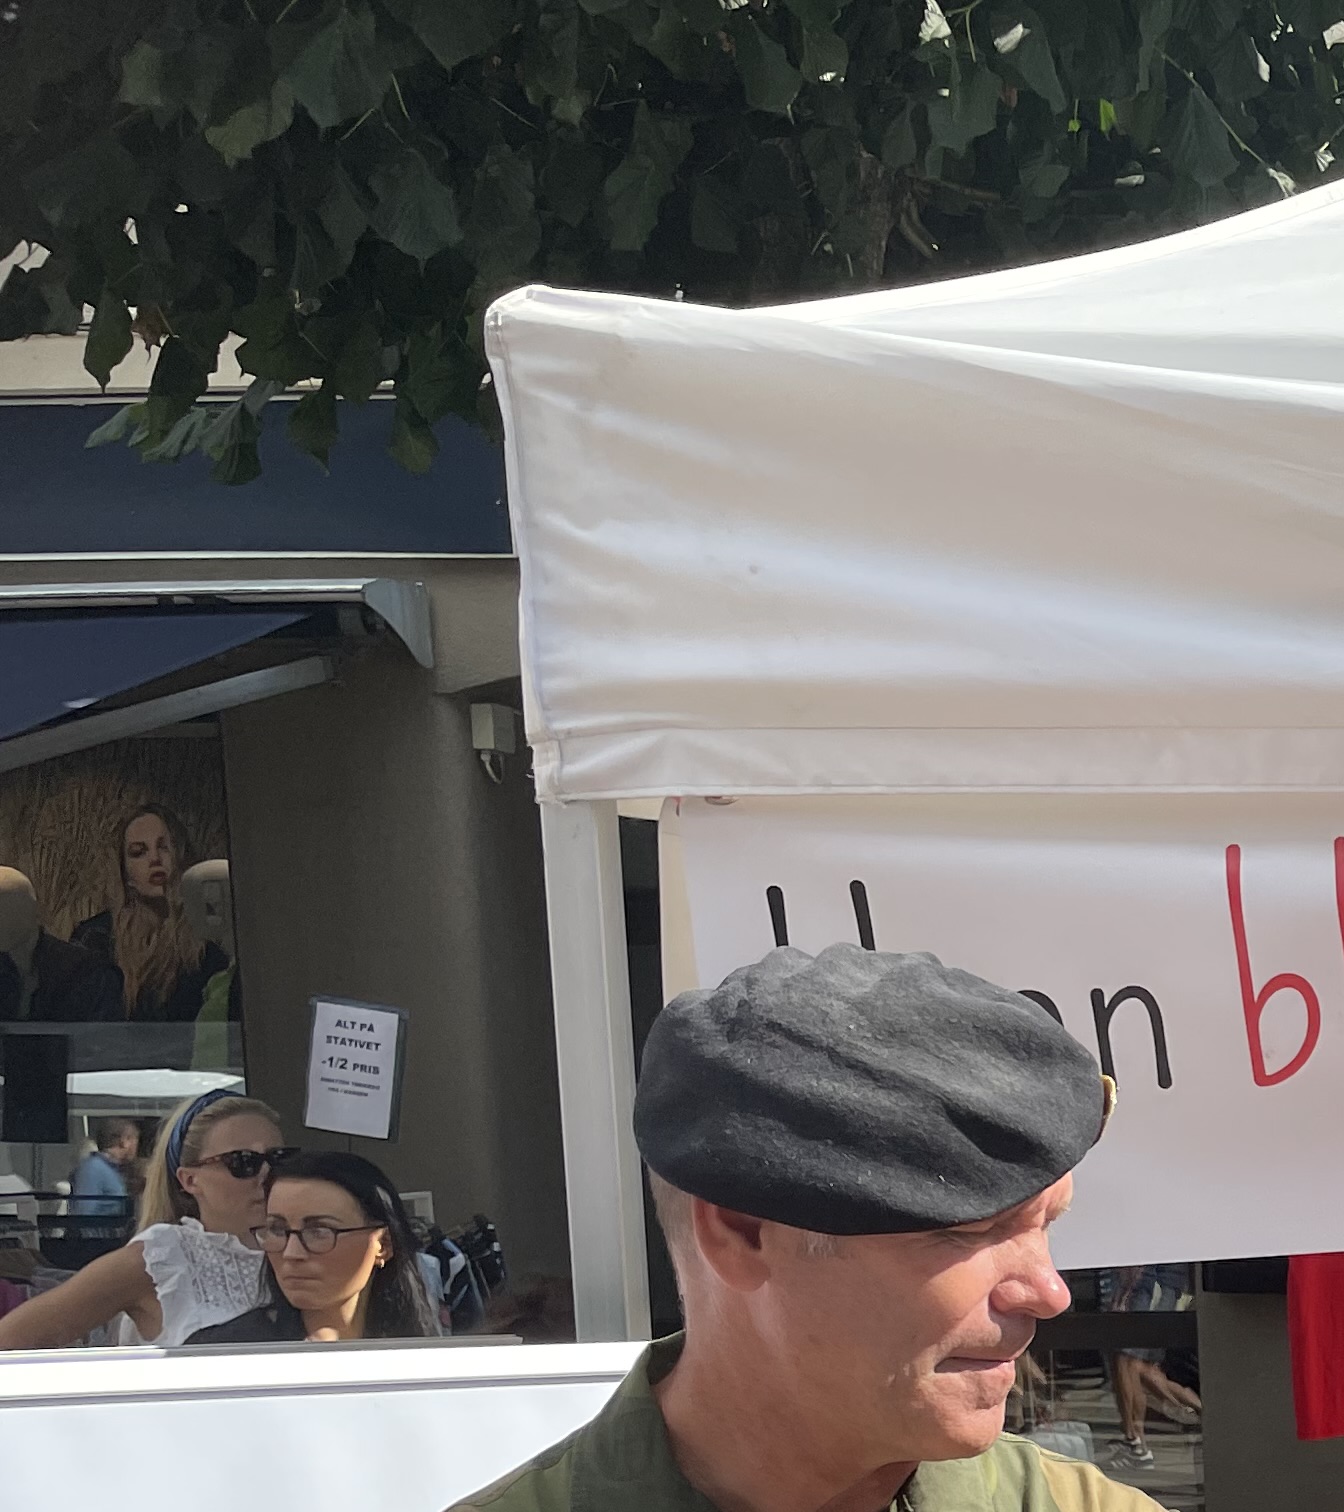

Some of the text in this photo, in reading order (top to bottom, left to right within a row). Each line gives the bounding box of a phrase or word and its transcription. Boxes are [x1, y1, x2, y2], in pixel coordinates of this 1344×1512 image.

[335, 1019, 375, 1033] ALT PÅ
[326, 1035, 381, 1051] STATIVET
[321, 1056, 380, 1075] -1/2 PRIS
